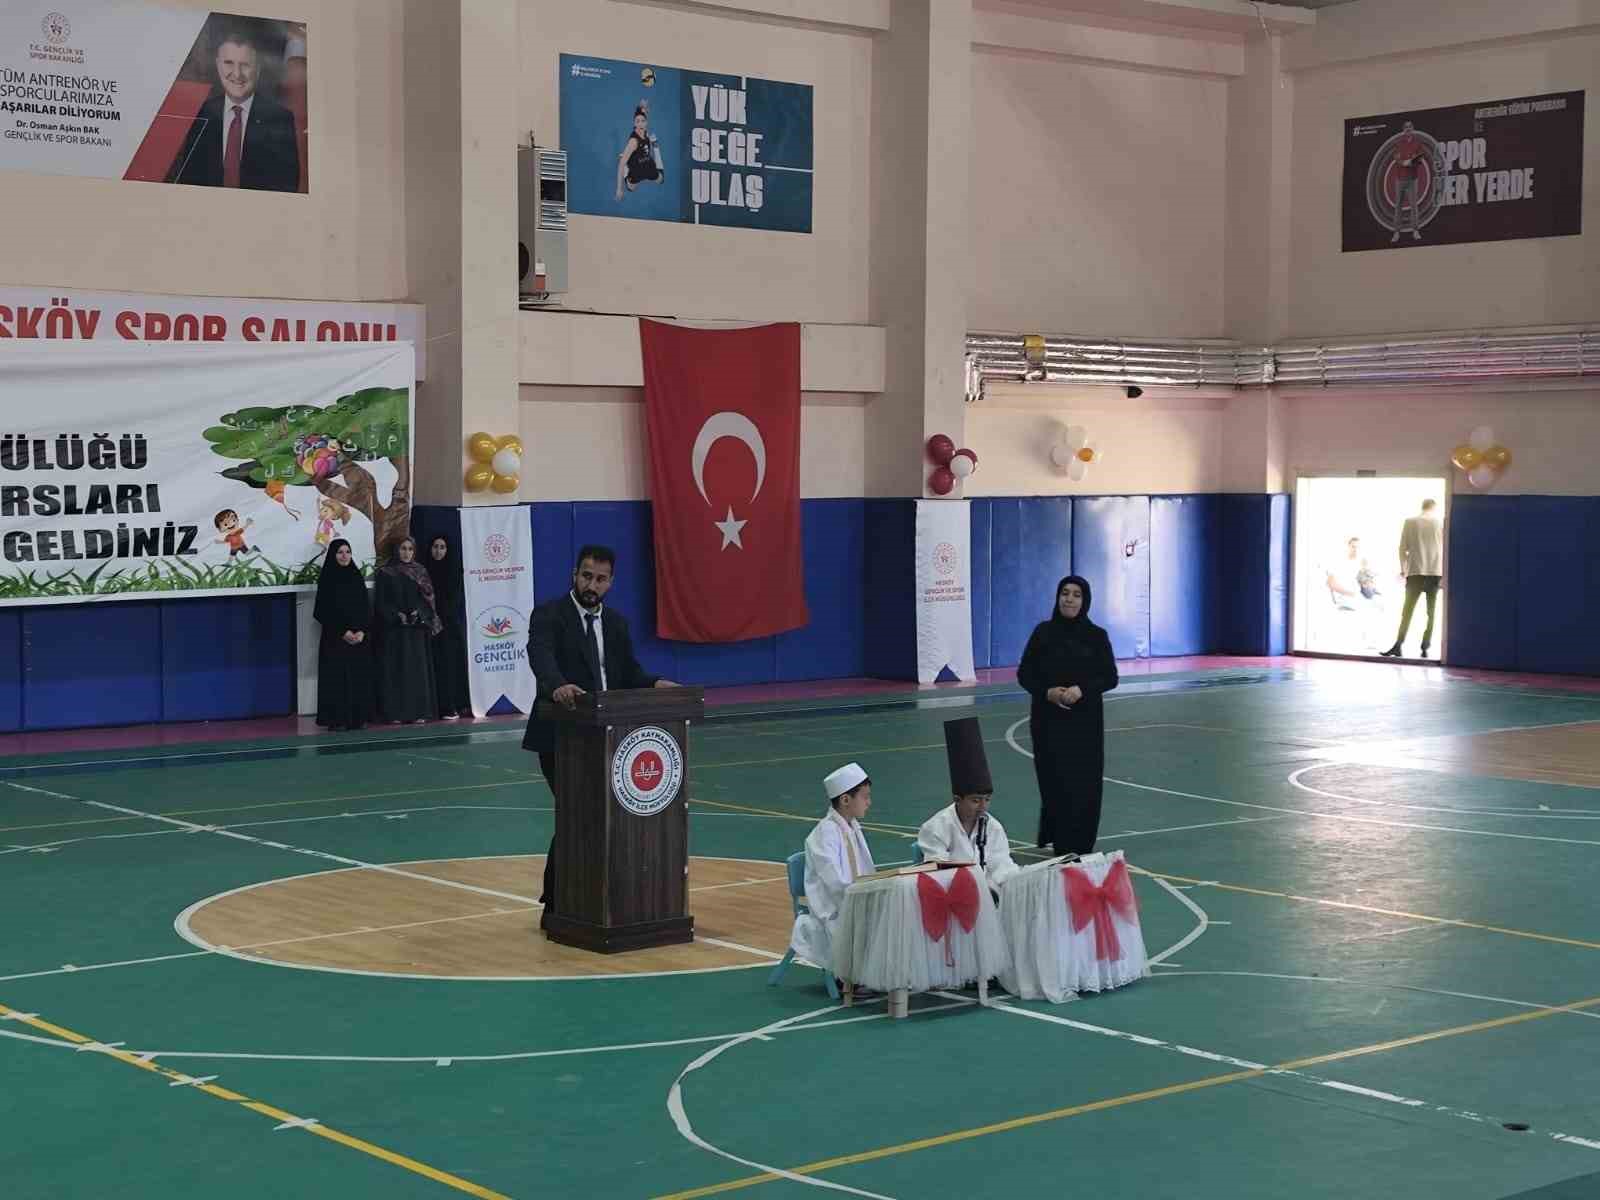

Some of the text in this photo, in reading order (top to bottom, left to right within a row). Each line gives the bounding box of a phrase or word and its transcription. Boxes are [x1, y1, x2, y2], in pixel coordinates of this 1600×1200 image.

[0, 68, 118, 93] ÜM ANTRENÖR VE
[0, 84, 114, 106] SPORCULARIMIZA
[691, 83, 747, 125] YÜK
[1, 101, 121, 121] AŞARILAR DİLİYORUM
[4, 130, 112, 147] GENÇLİK VE SPOR BAKANI
[16, 119, 100, 135] Dr. Osman Aşkın BAK
[691, 127, 763, 168] SEĞE
[691, 168, 763, 213] ULAŞ
[1474, 167, 1535, 204] YERDE
[0, 433, 148, 471] ÜLÜĞÜ
[0, 484, 162, 516] RSLARI
[3, 521, 199, 562] GELDİNİZ
[474, 648, 525, 664] GENÇLİK
[484, 641, 514, 650] HASKÖY
